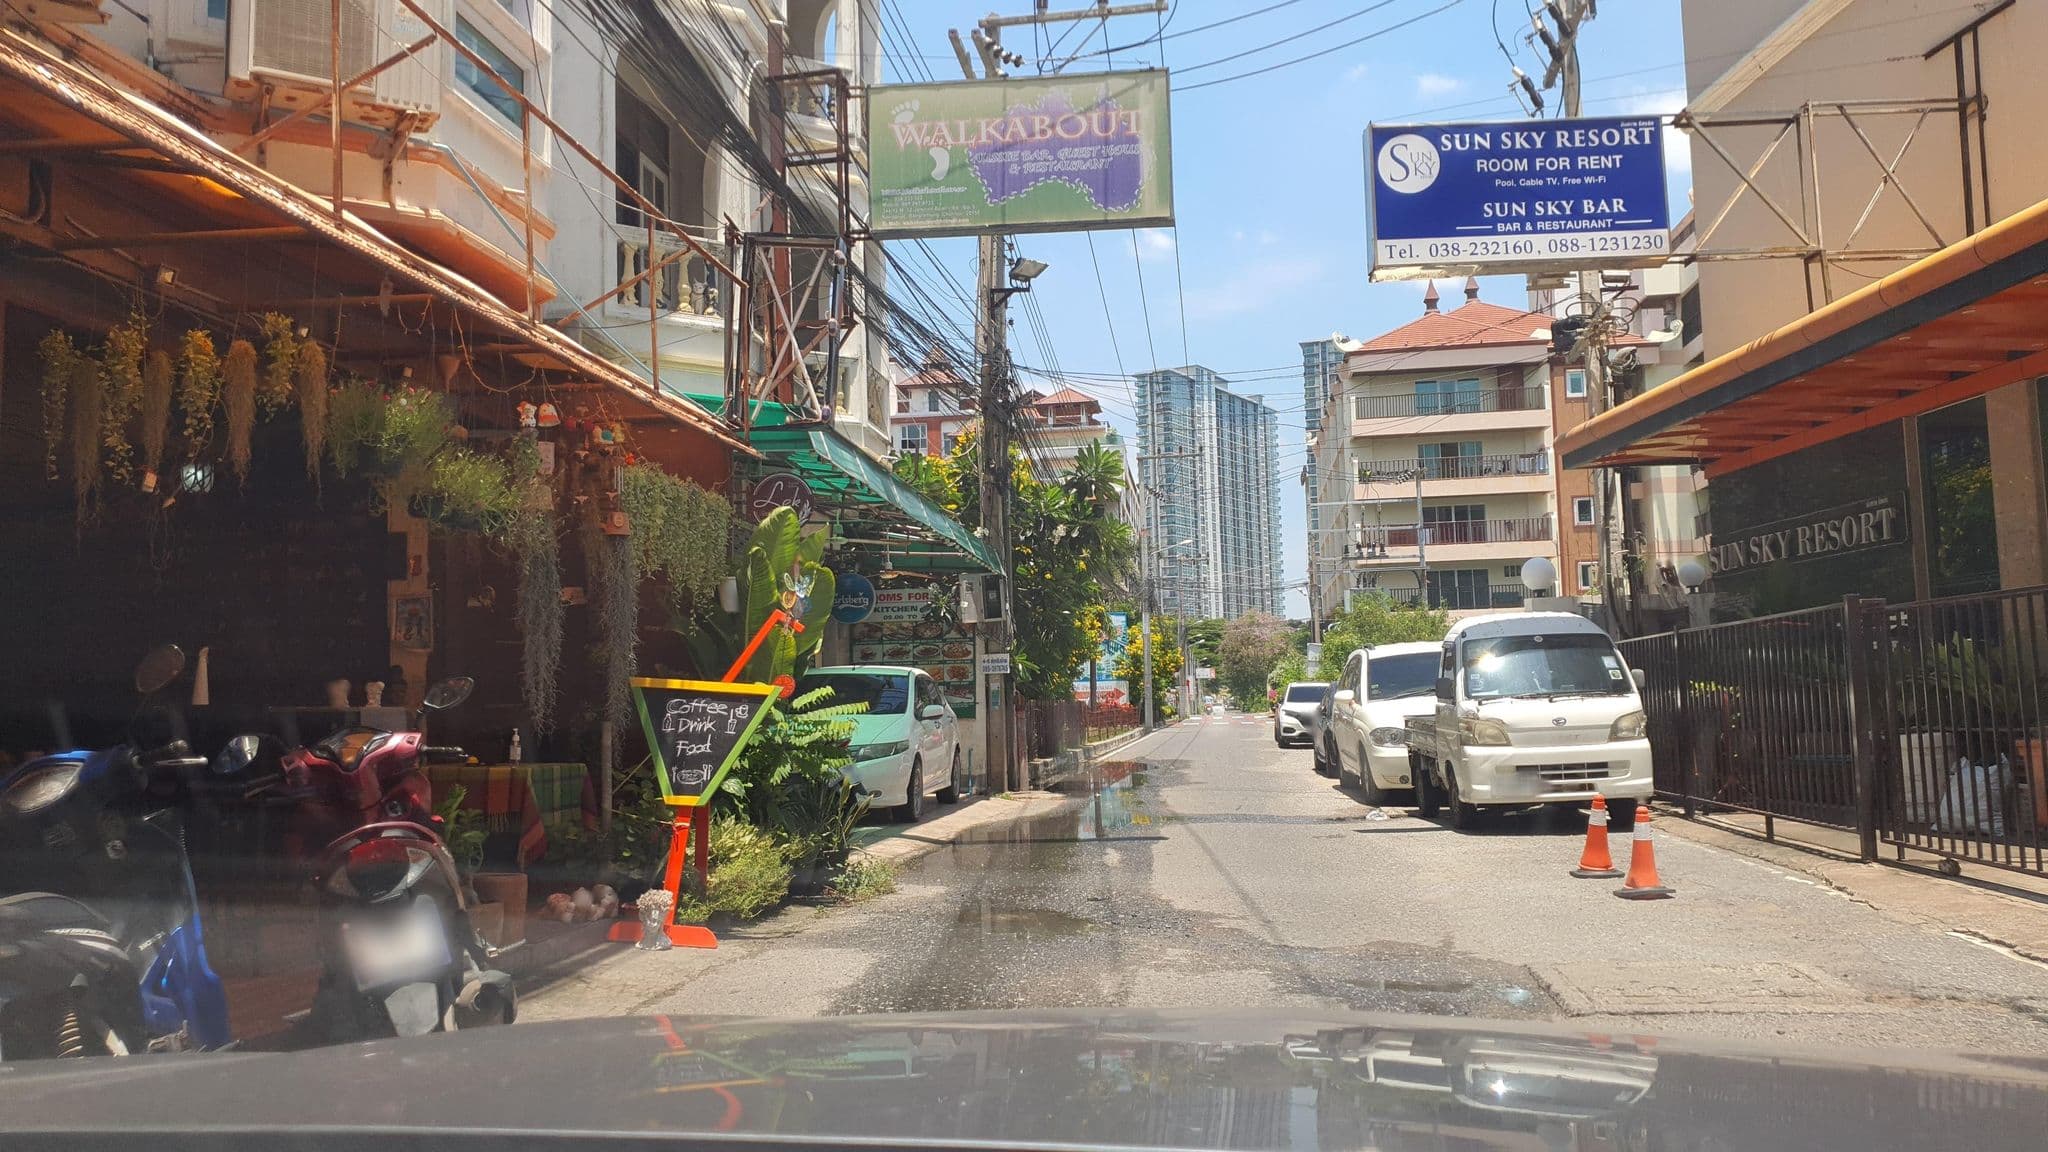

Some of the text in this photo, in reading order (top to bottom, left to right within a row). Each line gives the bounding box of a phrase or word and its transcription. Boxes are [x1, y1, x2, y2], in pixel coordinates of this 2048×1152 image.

[888, 109, 1143, 149] WALKABOUT
[1441, 127, 1655, 151] SUN SKY RESORT
[1022, 157, 1113, 174] RESTAURANT
[1476, 155, 1623, 172] ROOM FOR RENT
[1519, 178, 1543, 187] Cable
[1562, 176, 1581, 185] Free
[1584, 175, 1606, 185] Wi-Fi
[1483, 198, 1627, 218] SUN SKY BAR
[1497, 218, 1613, 233] BAR & RESTAURANT
[1385, 243, 1419, 259] Tel.
[1548, 234, 1664, 253] 088-1231230
[1709, 507, 1895, 574] SUN SKY RESORT
[878, 592, 929, 602] OMS FOR
[873, 605, 918, 613] KITCHEN
[666, 698, 729, 716] Coffee
[677, 715, 717, 734] Drink
[675, 733, 713, 757] Food
